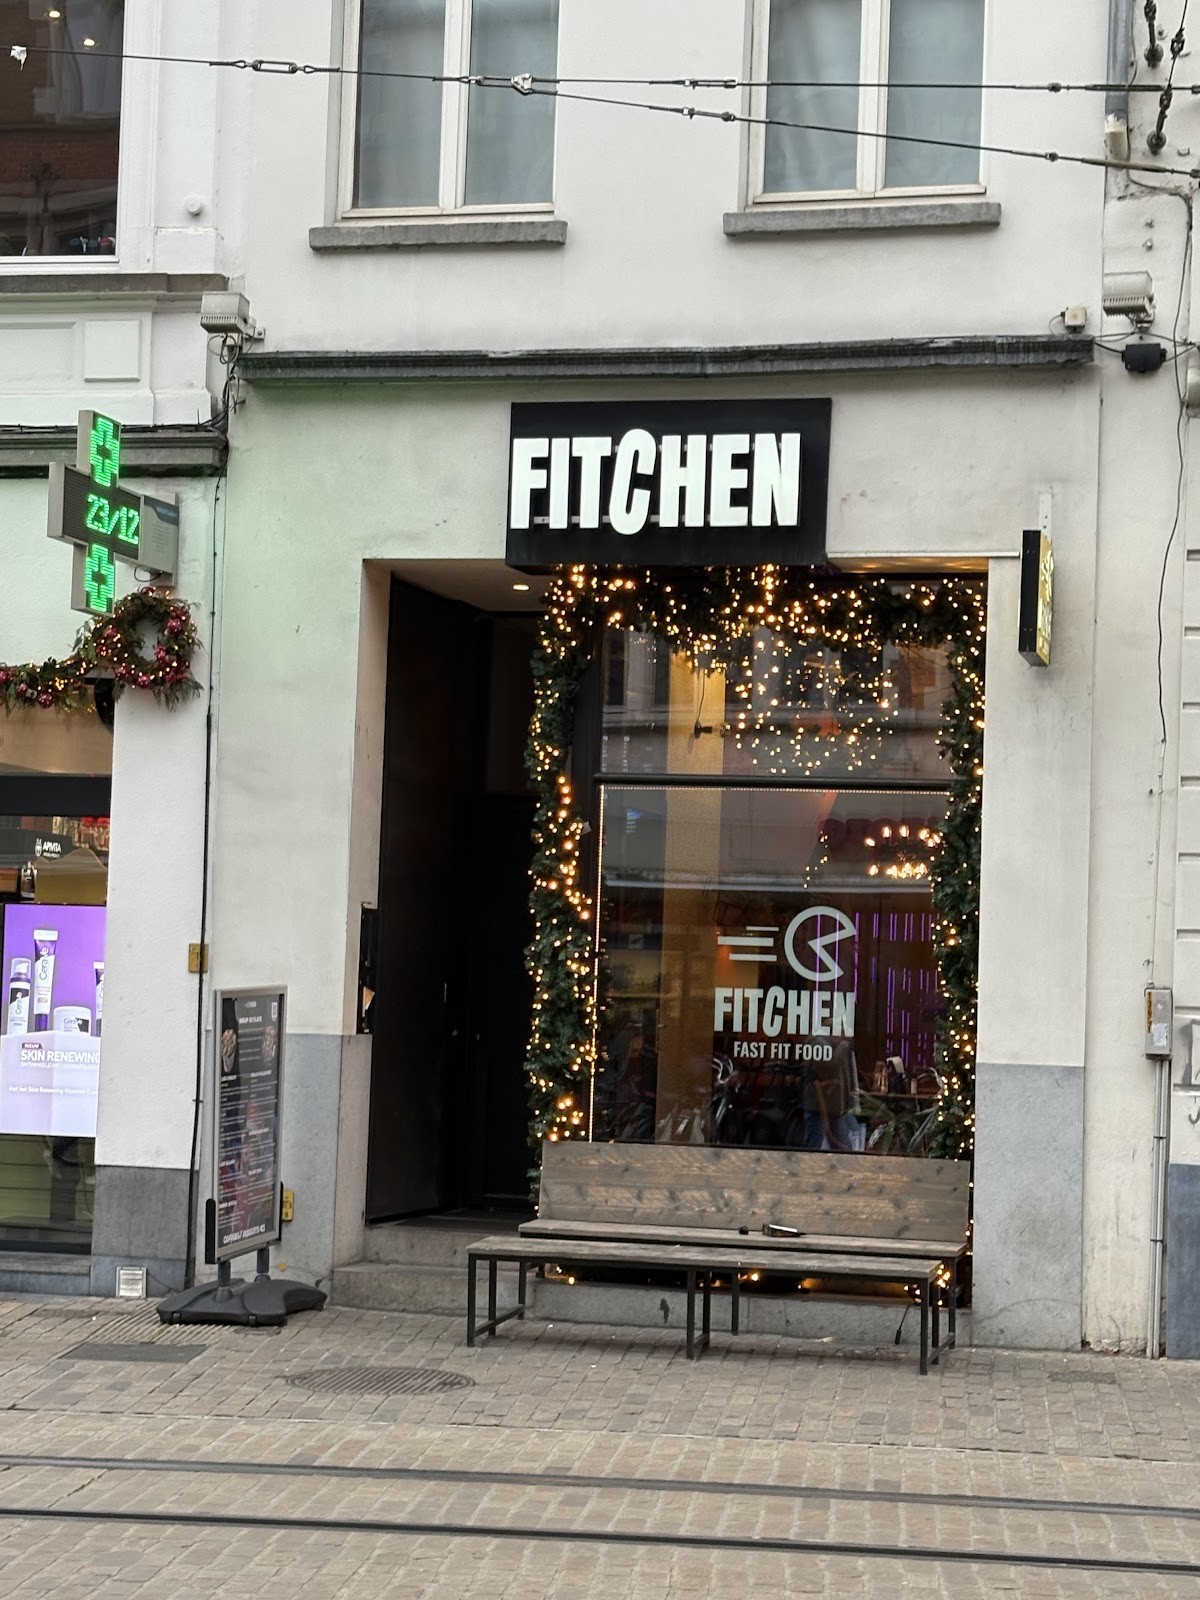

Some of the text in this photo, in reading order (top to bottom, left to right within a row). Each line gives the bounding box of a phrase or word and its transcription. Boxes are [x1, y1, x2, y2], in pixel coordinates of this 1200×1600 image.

[510, 428, 801, 535] FITCHEN
[86, 493, 140, 545] 23/12
[713, 985, 856, 1038] FITCHEN
[20, 1050, 46, 1062] SKIN
[733, 1041, 833, 1062] FAST FIT FOOD
